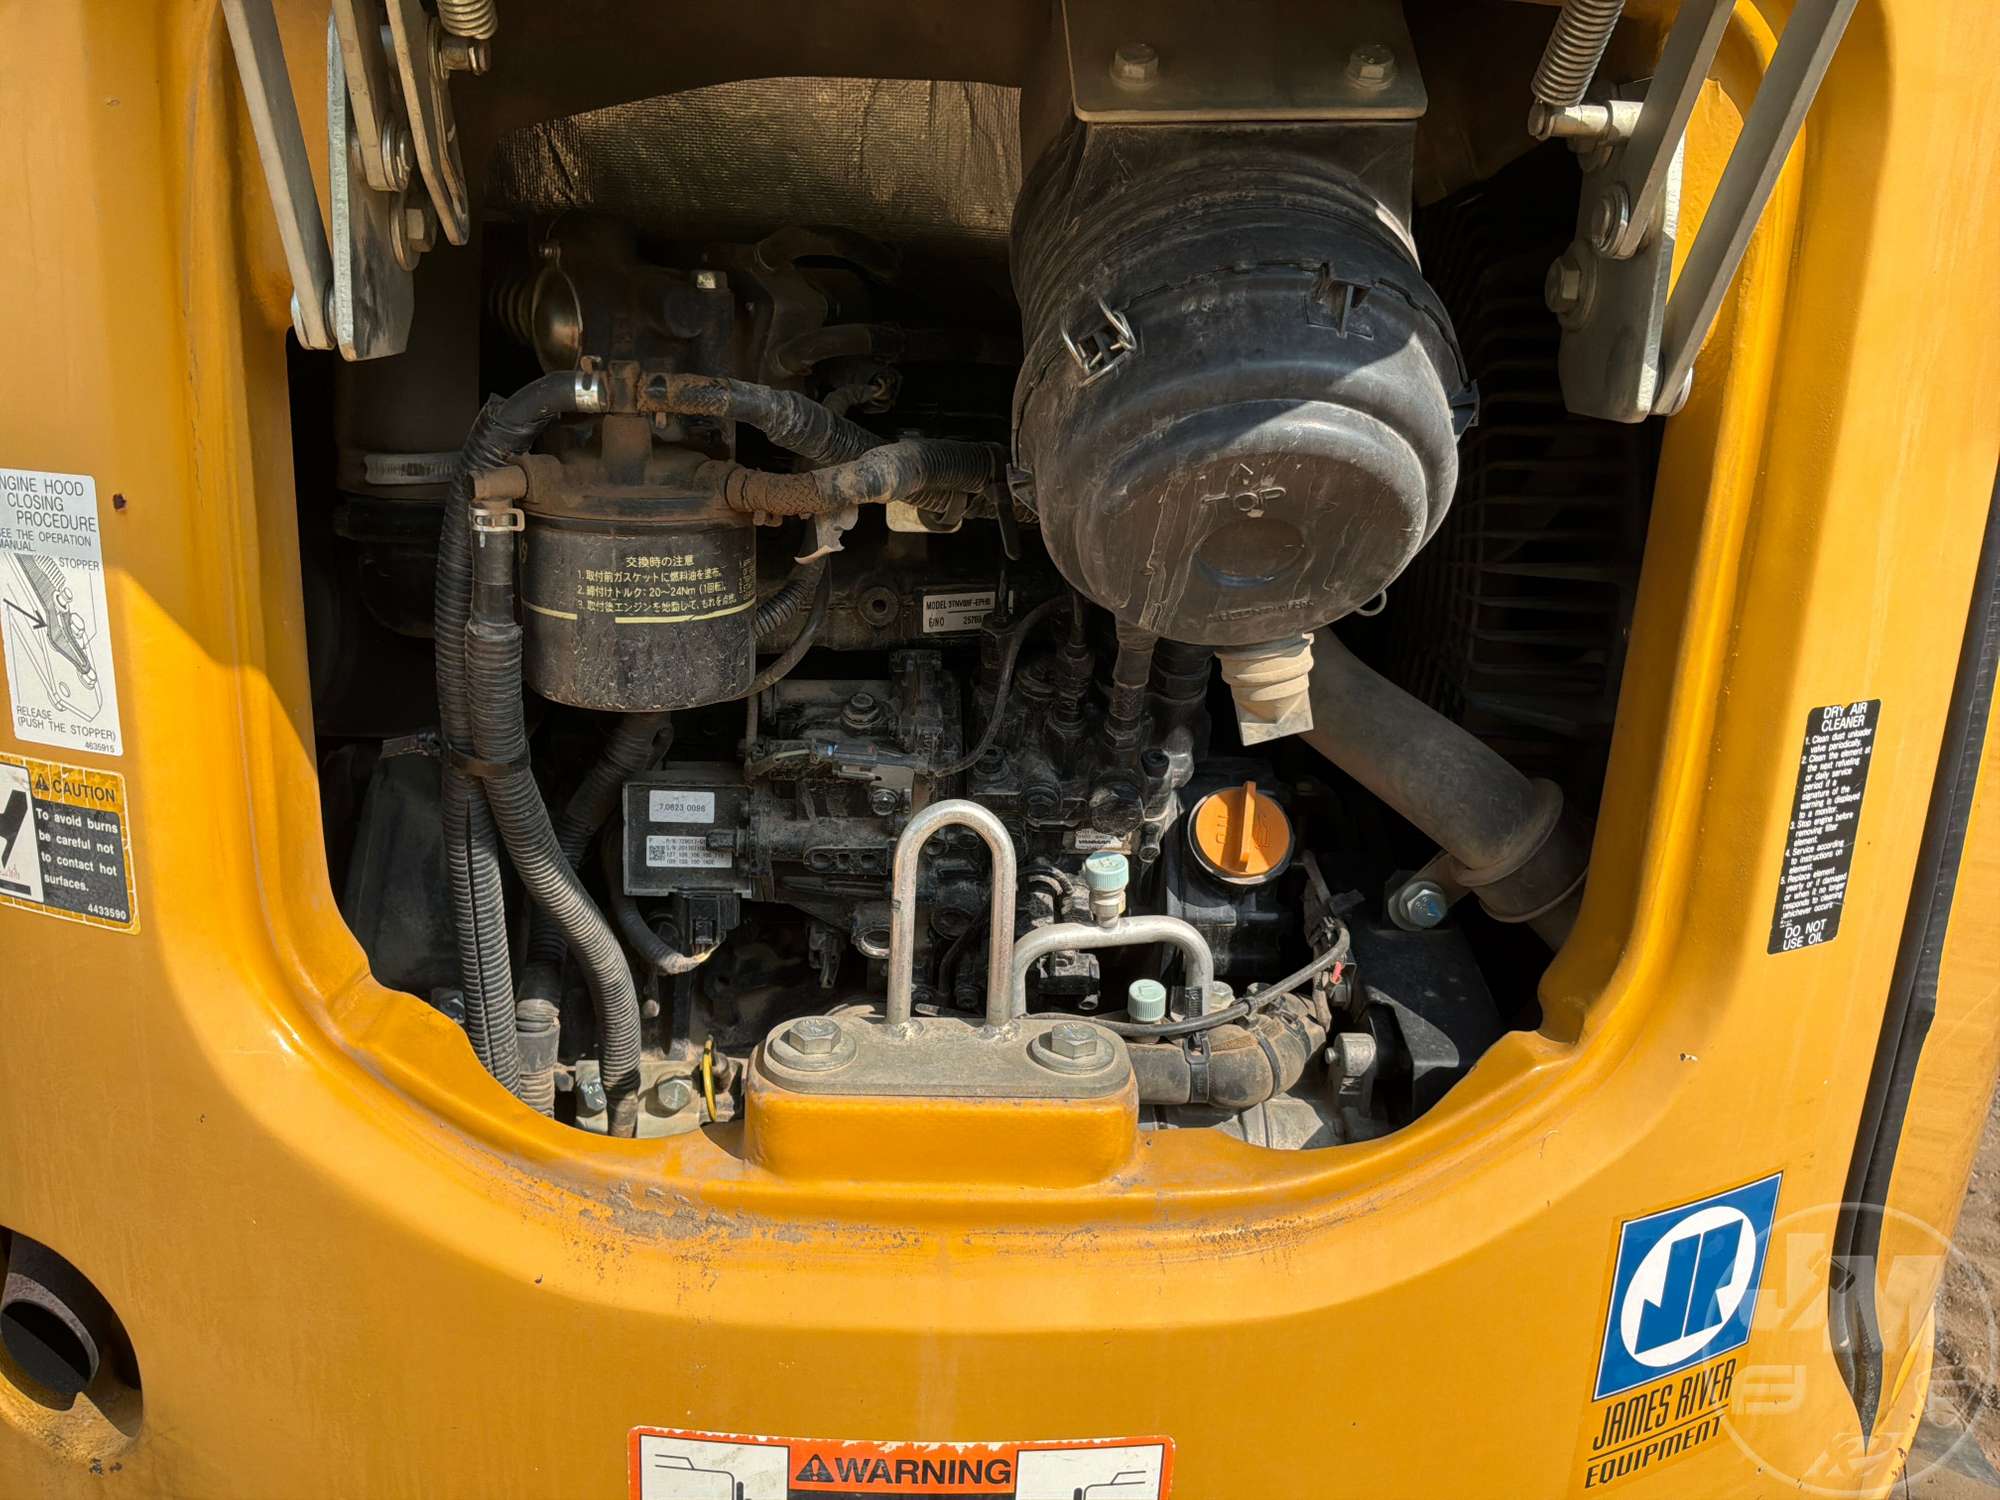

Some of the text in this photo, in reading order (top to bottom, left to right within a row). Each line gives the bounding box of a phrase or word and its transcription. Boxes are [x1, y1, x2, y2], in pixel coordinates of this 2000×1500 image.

[44, 480, 84, 496] HOOD
[7, 492, 64, 512] CLOSING
[1201, 486, 1287, 512] TOP
[16, 510, 97, 533] PROCEDURE
[16, 528, 35, 542] THE
[38, 531, 92, 548] OPERATION
[59, 556, 100, 572] STOPPER
[625, 554, 695, 569] 交換時の注意
[926, 600, 946, 610] MODEL
[16, 705, 53, 720] RELEASE
[1824, 702, 1868, 719] DRY AIR
[18, 716, 116, 741] (PUSH THE STOPPER)
[1822, 715, 1865, 732] CLEANER
[1812, 734, 1830, 744] Clean
[1832, 732, 1844, 740] dust
[1808, 754, 1826, 764] Clean
[1828, 752, 1838, 760] the
[1840, 747, 1862, 758] element
[1805, 768, 1852, 782] or daily service
[1807, 764, 1818, 772] the
[53, 780, 116, 802] CAUTION
[1803, 781, 1823, 792] period
[1832, 787, 1838, 796] of
[1840, 785, 1850, 794] the
[1800, 800, 1824, 810] warning
[35, 808, 118, 834] To avoid burns
[1797, 820, 1812, 828] Stop
[1814, 816, 1833, 826] engine
[1835, 812, 1854, 822] before
[1796, 828, 1822, 838] removing
[38, 830, 114, 855] be careful not
[1792, 846, 1814, 856] Service
[41, 852, 118, 877] to contact hot
[44, 872, 90, 892] surfaces.
[1788, 873, 1811, 884] Replace
[1812, 867, 1836, 878] element
[1784, 894, 1791, 902] or
[1794, 890, 1810, 900] when
[1818, 886, 1826, 894] no
[1786, 883, 1804, 894] yearly
[1812, 896, 1818, 904] to
[88, 903, 126, 920] 4433590
[1784, 925, 1800, 939] DO
[1806, 918, 1828, 934] NOT
[1782, 936, 1804, 950] USE
[1592, 1358, 1736, 1451] JAMES RIVER
[1584, 1415, 1724, 1489] EQUIPMENT
[833, 1458, 1011, 1485] WARNING
